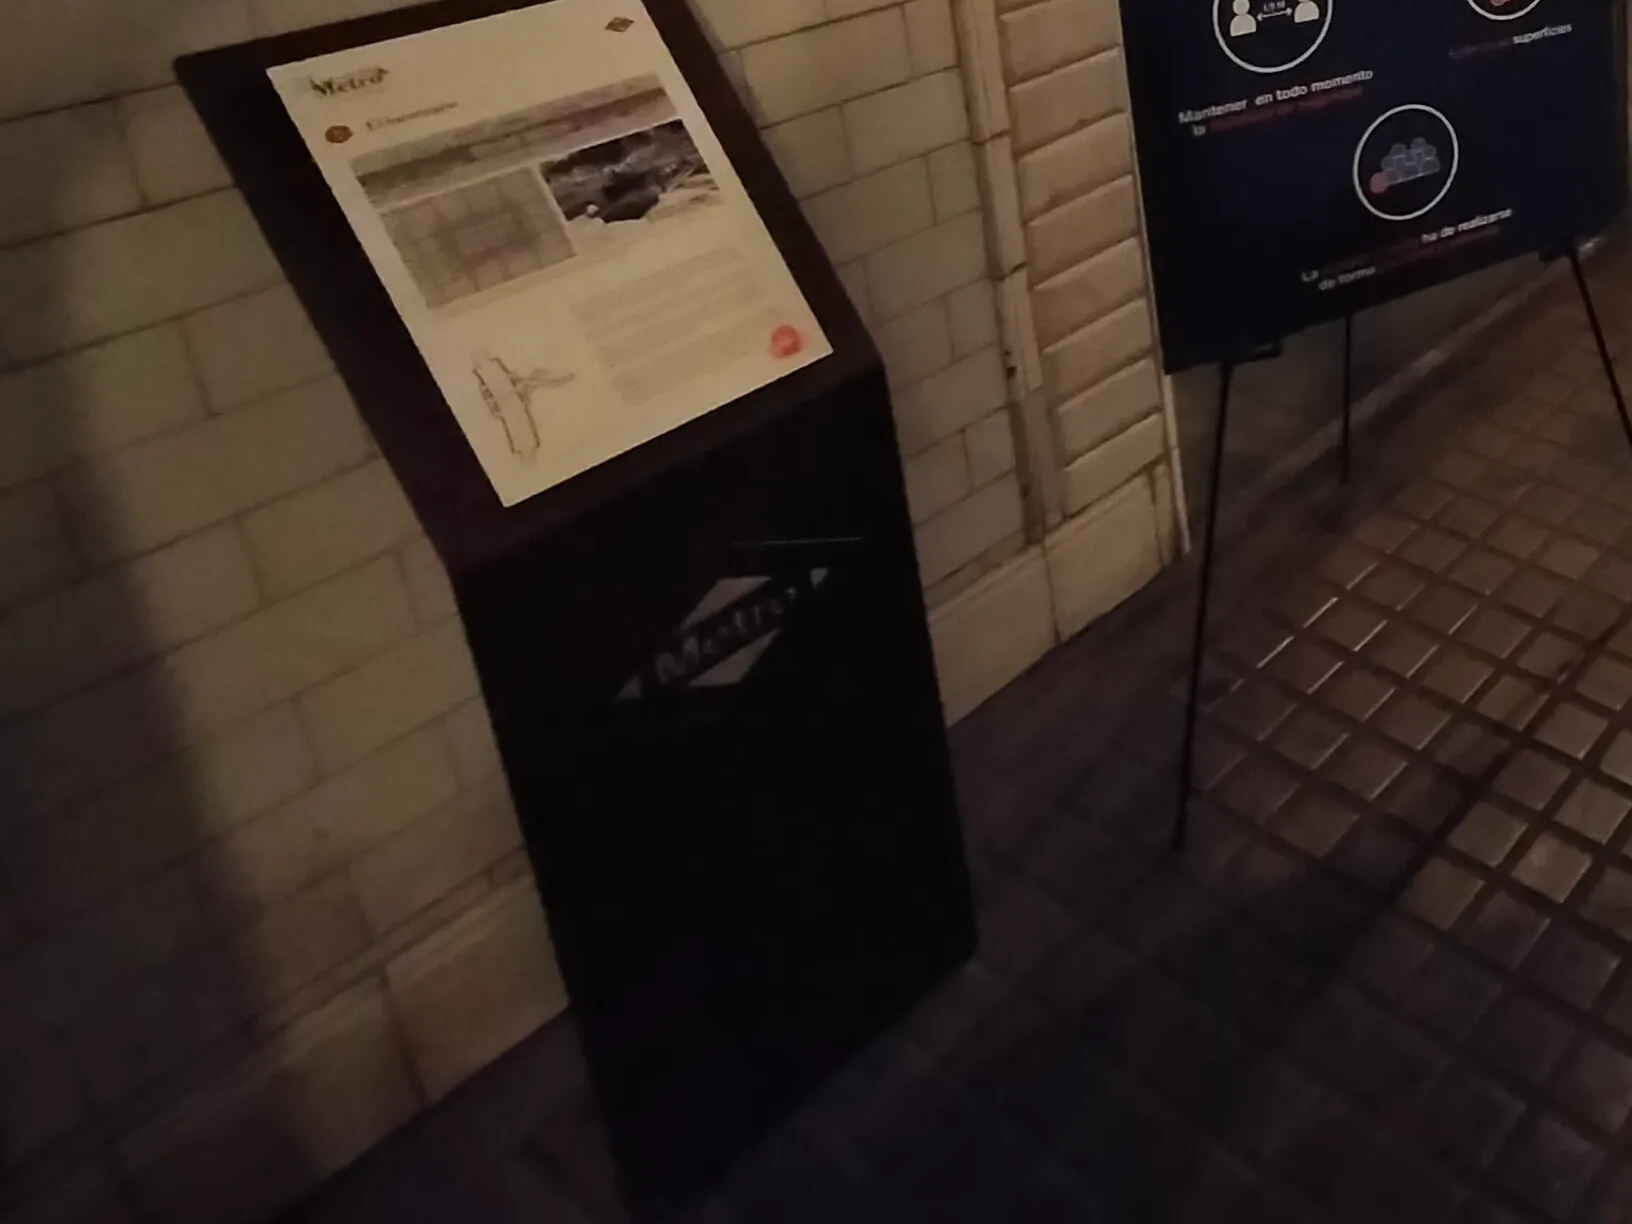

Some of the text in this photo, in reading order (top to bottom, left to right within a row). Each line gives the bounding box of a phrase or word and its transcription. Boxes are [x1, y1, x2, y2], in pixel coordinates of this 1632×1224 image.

[1177, 97, 1248, 124] Mantener
[1253, 93, 1273, 106] en
[1275, 84, 1308, 101] todo
[1310, 69, 1374, 92] momento
